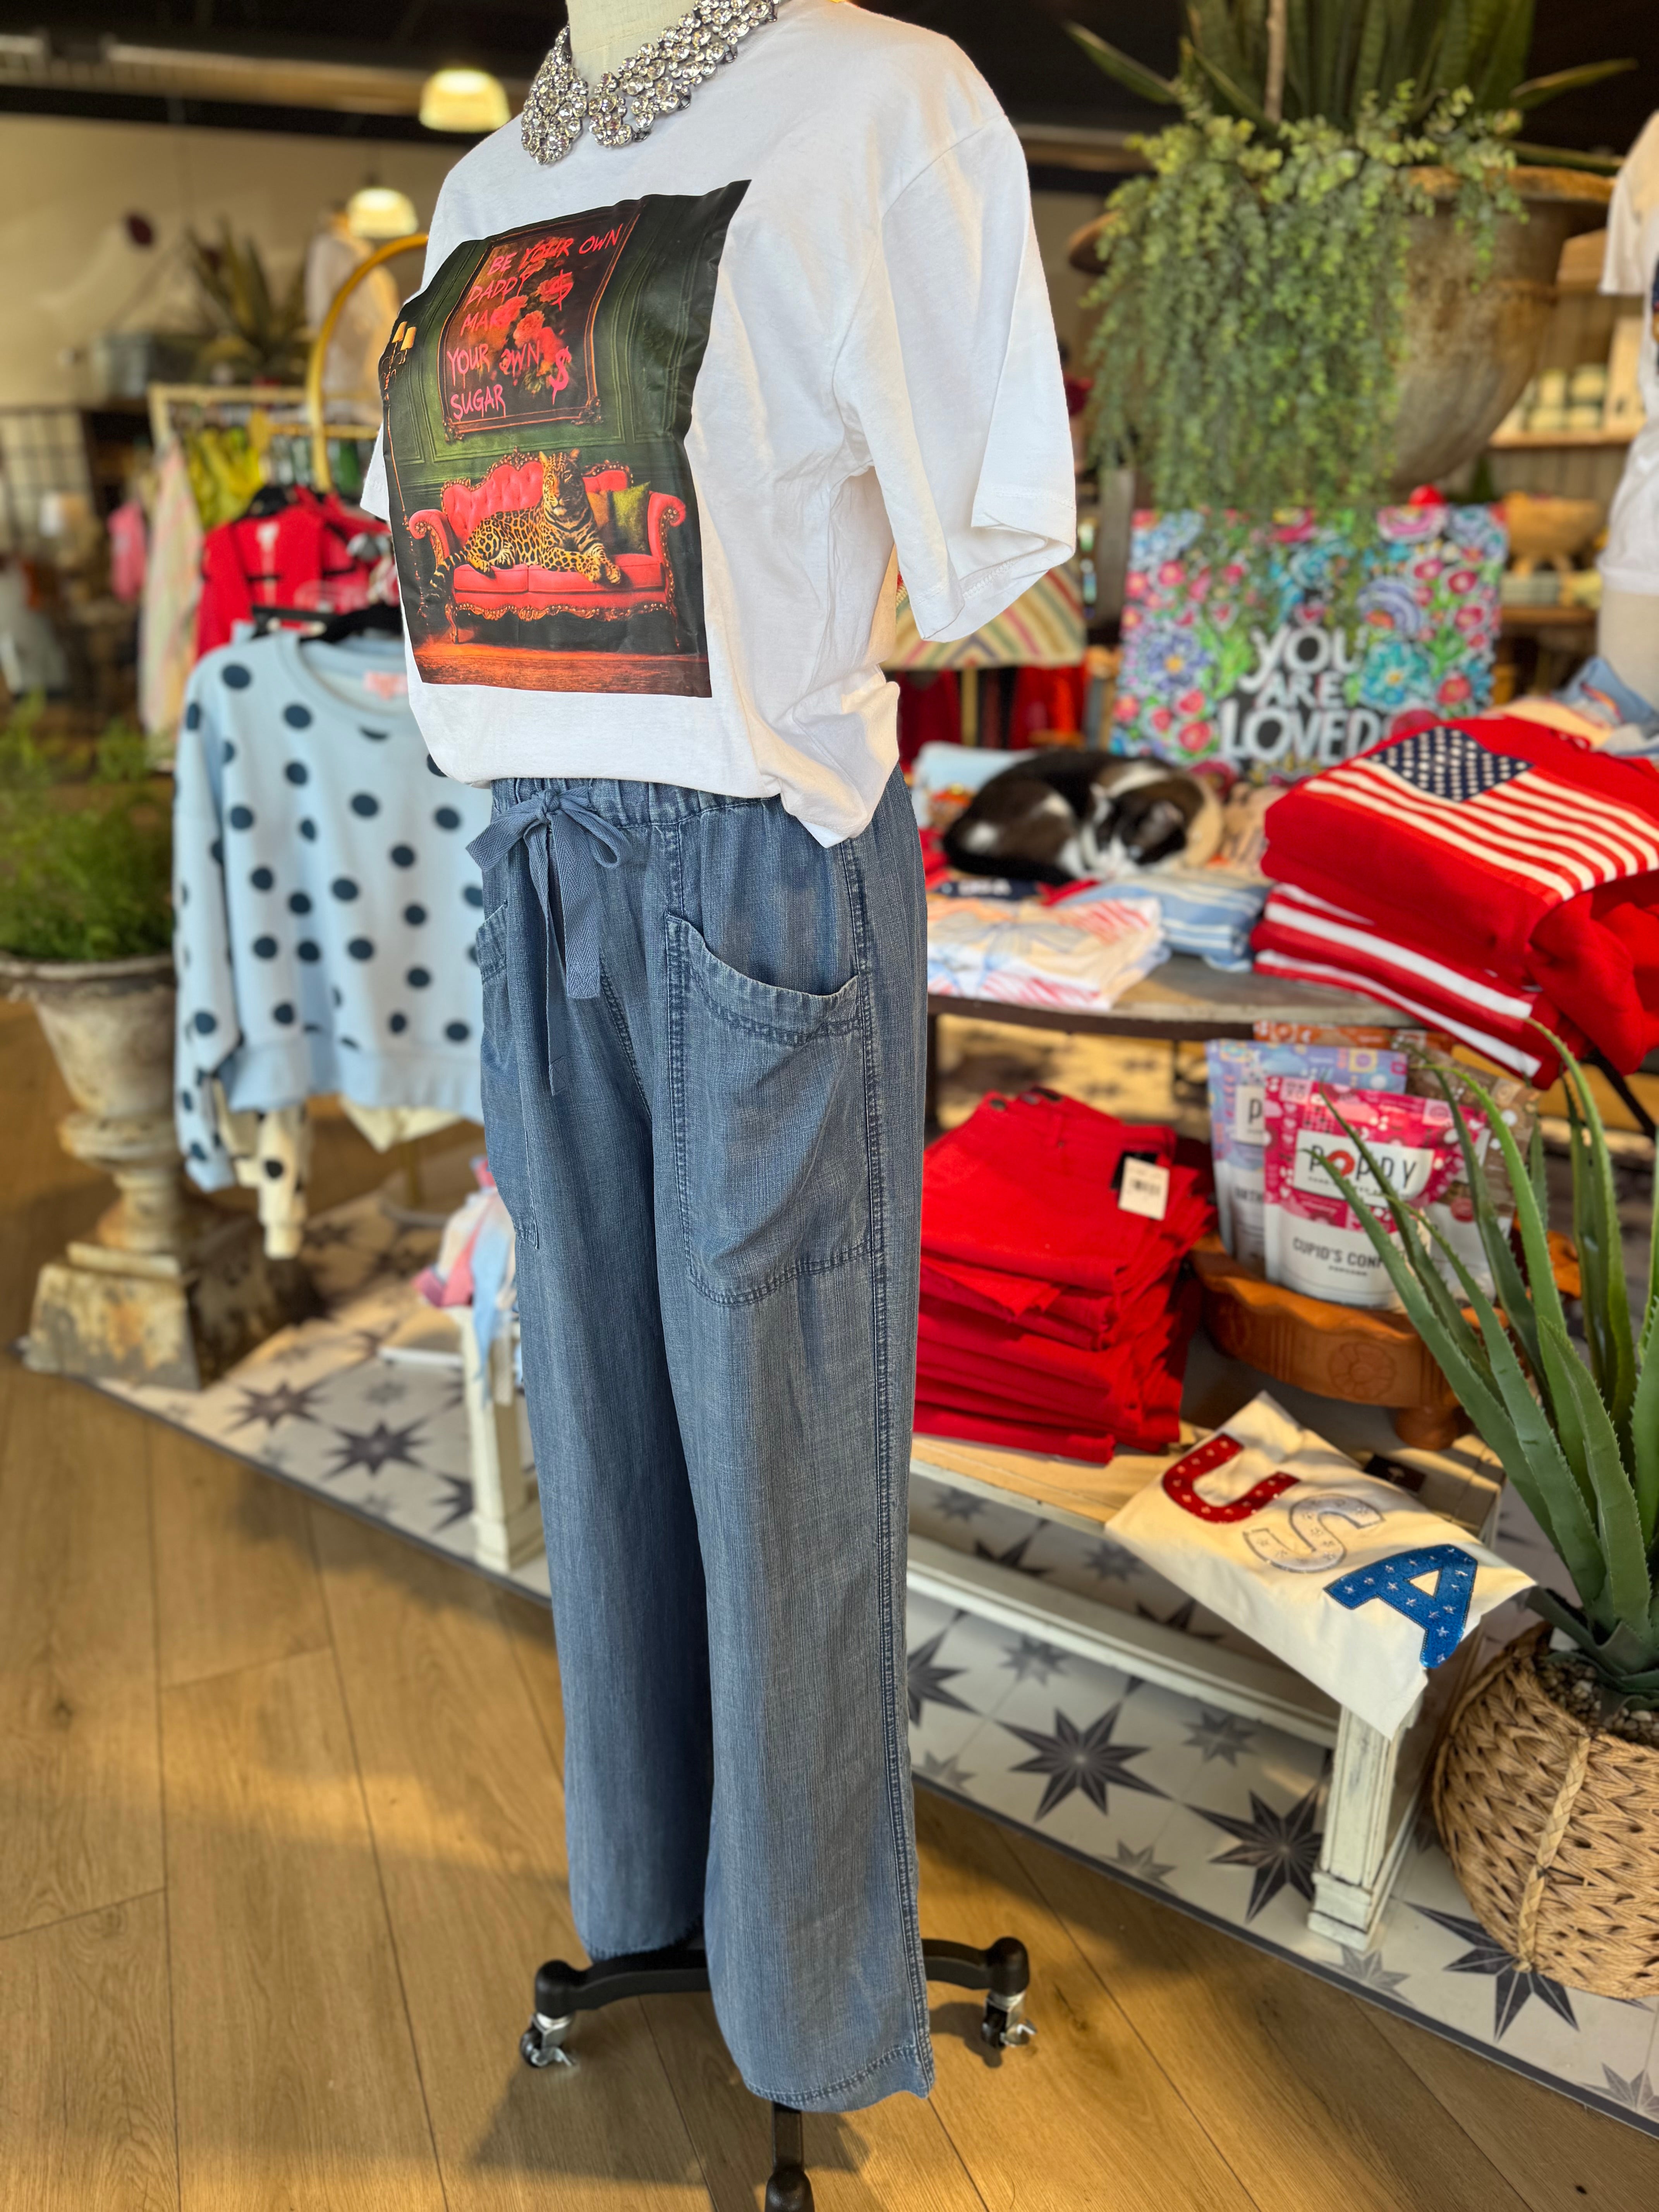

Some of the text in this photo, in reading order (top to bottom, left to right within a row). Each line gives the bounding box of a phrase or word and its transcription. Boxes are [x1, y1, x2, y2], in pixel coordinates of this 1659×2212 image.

[487, 223, 623, 275] BE YOUR OWN
[447, 343, 489, 389] YOUR
[499, 340, 539, 376] OWN
[450, 384, 506, 421] SUGAR
[1238, 623, 1368, 693] YOU
[1254, 671, 1345, 709] ARE
[1220, 698, 1382, 766] LOVED
[1162, 1433, 1478, 1668] USA
